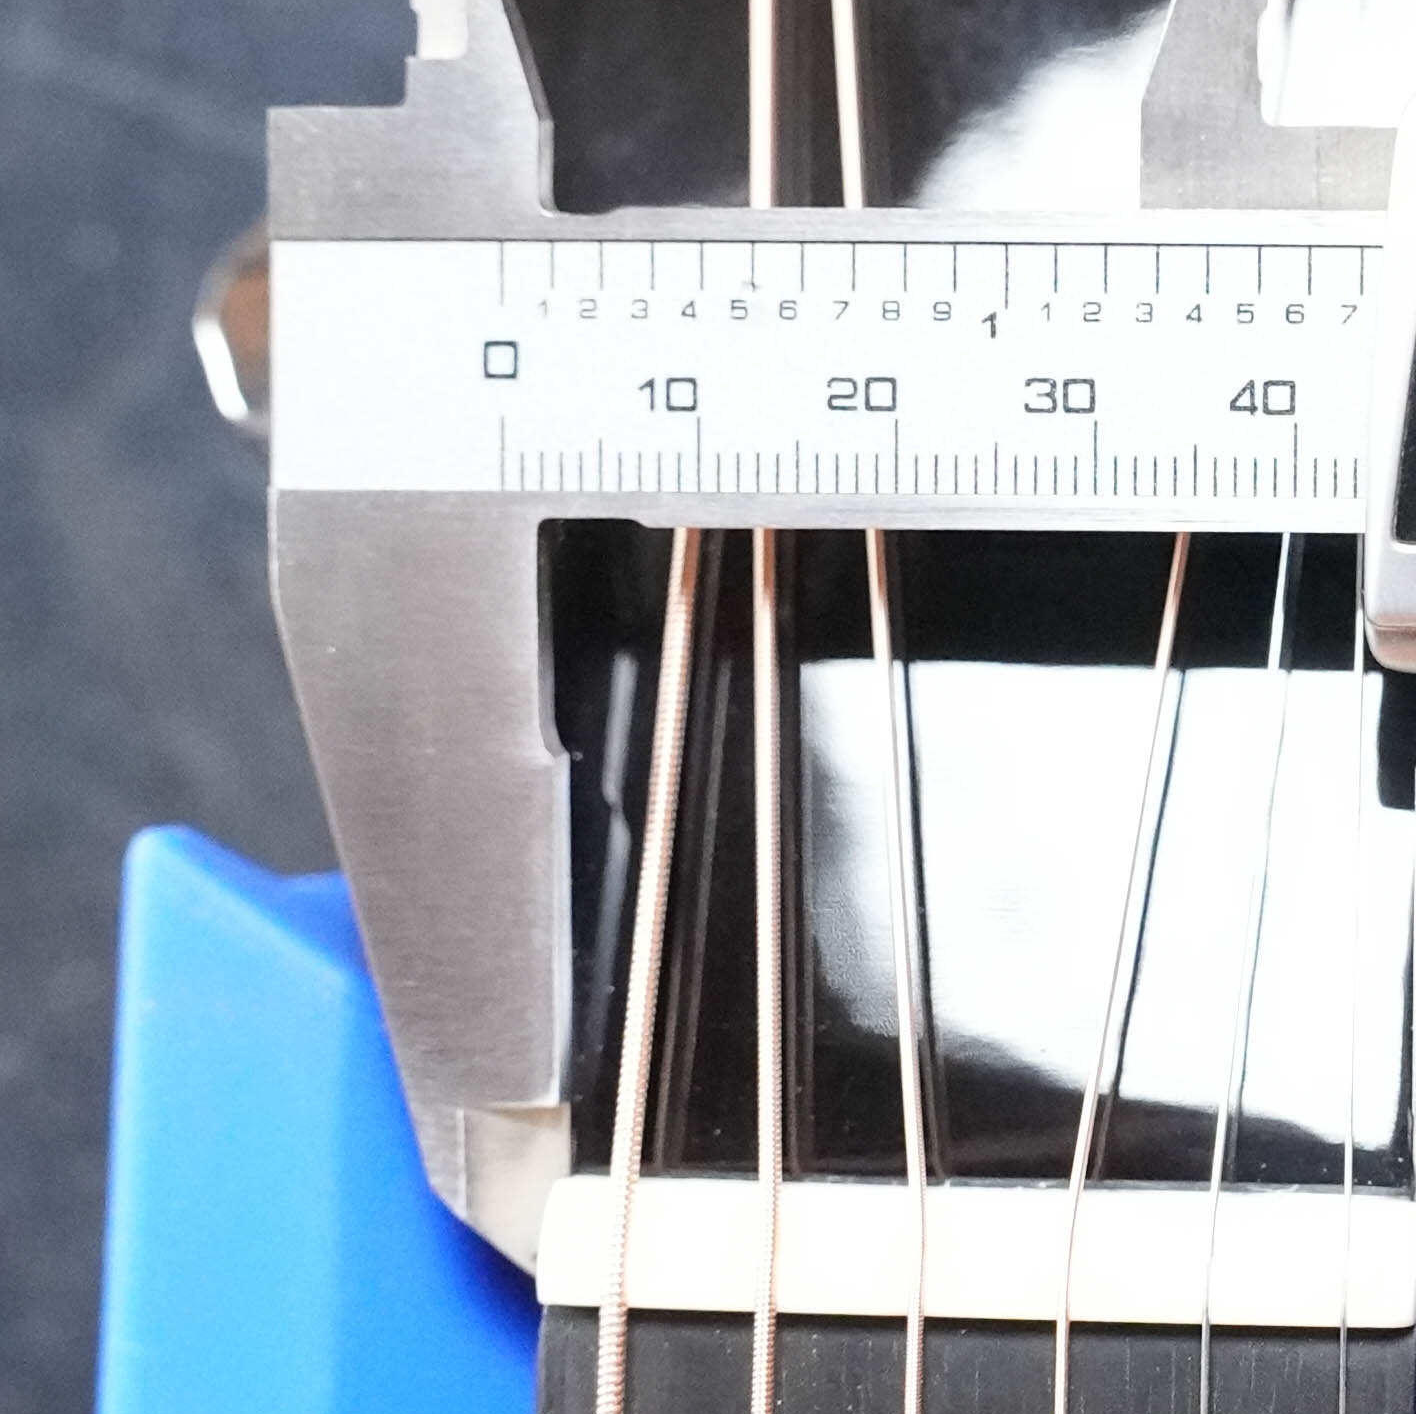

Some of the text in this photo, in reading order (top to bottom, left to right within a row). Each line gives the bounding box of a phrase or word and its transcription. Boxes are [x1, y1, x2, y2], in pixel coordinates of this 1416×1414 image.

[538, 299, 1358, 339] 1 2 3 4 5 6 7 8 9 1 1 2 3 4 5 6 7
[483, 340, 520, 380] 0
[637, 377, 1296, 416] 10 20 30 40
